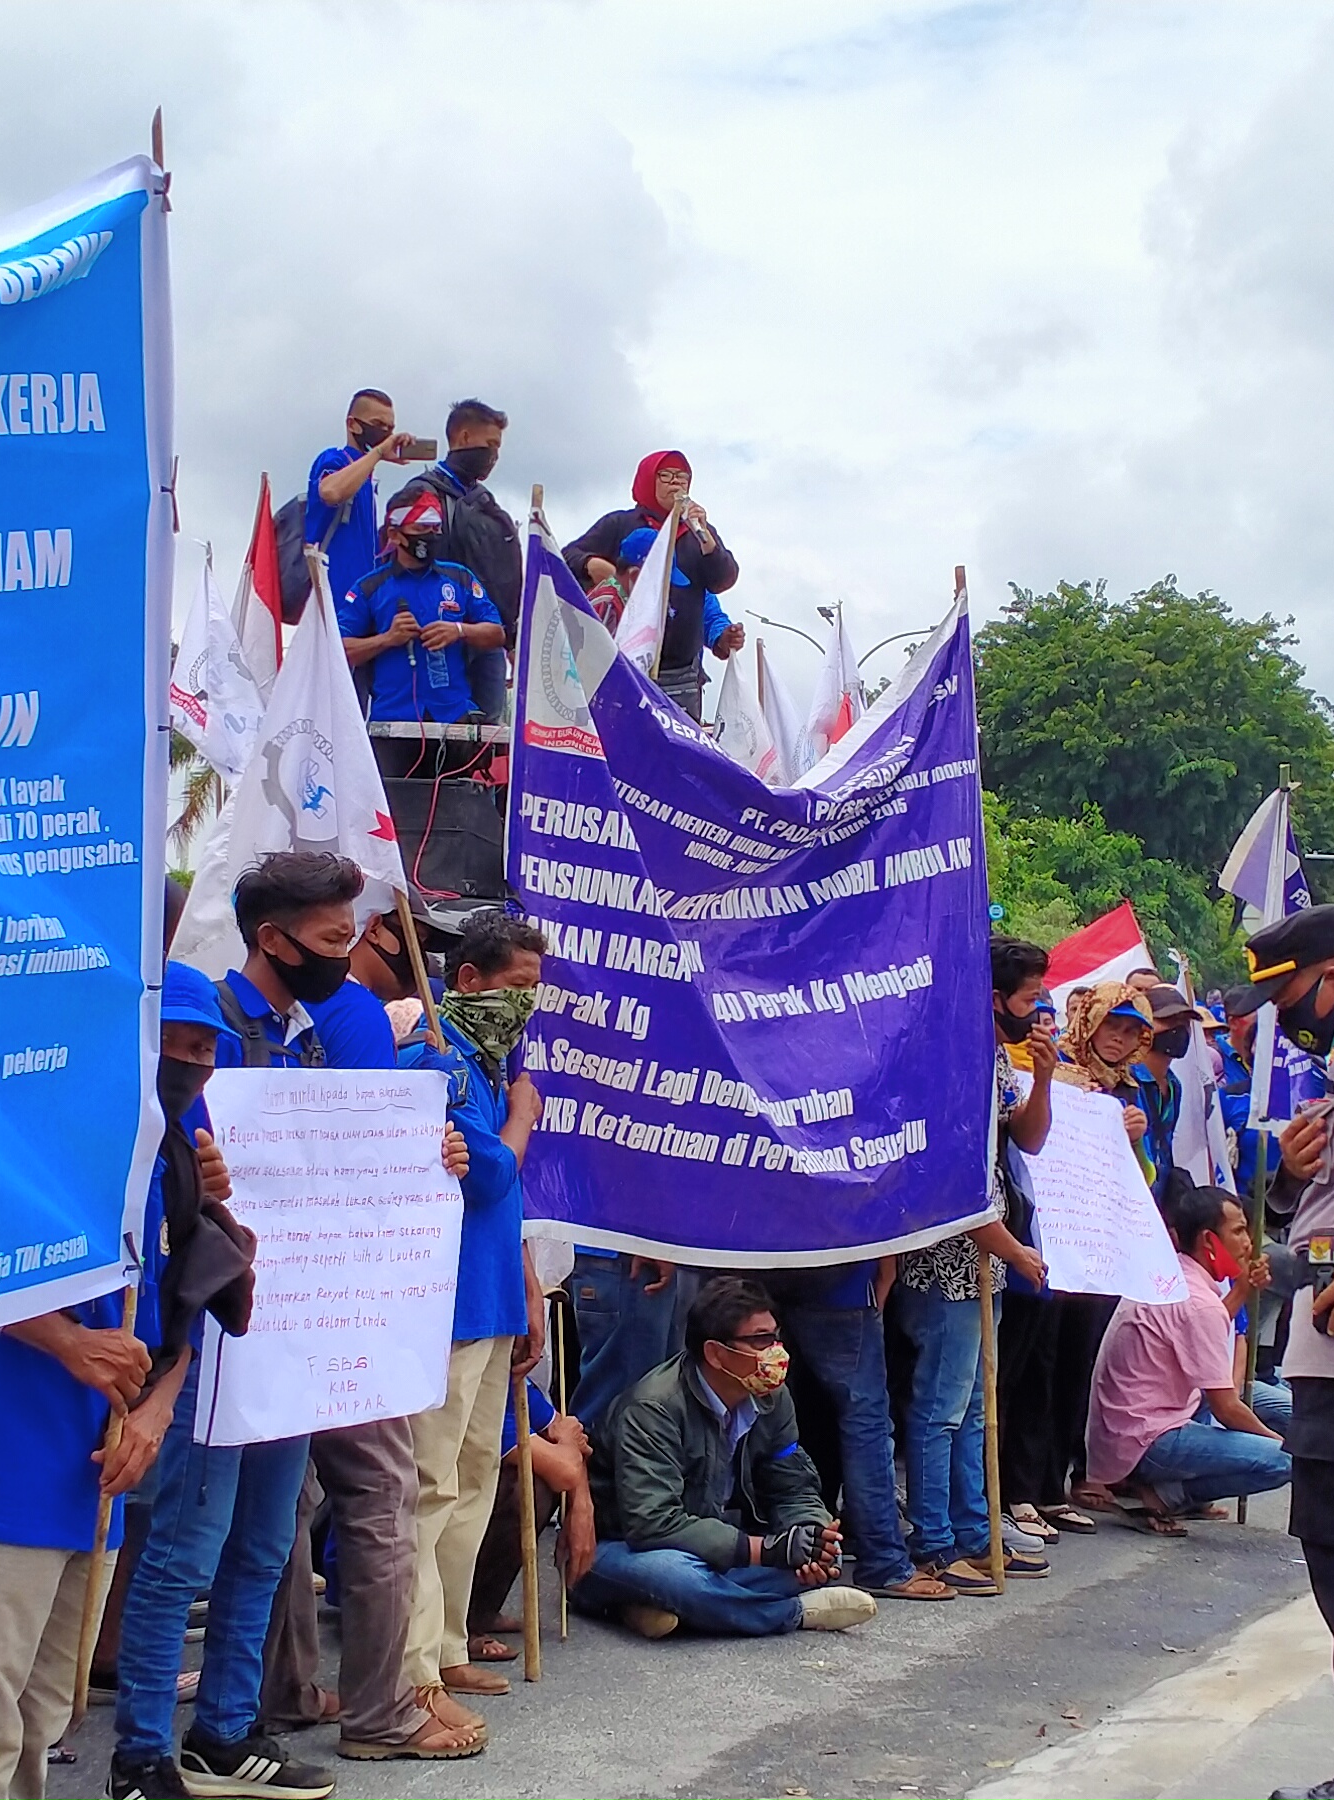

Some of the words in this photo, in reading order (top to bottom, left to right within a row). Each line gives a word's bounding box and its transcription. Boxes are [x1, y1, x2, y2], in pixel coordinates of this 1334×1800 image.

[9, 774, 66, 807] layak
[871, 797, 908, 822] 2015
[14, 809, 38, 840] 70
[41, 805, 103, 843] perak
[670, 810, 734, 847] MENTERI
[23, 838, 140, 878] pengusaha.
[807, 859, 880, 905] MOBIL
[4, 912, 67, 945] berikan
[613, 995, 652, 1041] Kg
[711, 990, 746, 1024] 40
[740, 983, 813, 1022] Perak
[810, 977, 847, 1014] Kg
[845, 953, 934, 1004] Menjadi
[2, 1042, 69, 1080] pekerja
[550, 1038, 644, 1093] Sesuai
[641, 1060, 701, 1106] Lagi
[540, 1095, 579, 1134] PKB
[578, 1101, 721, 1163] Ketentuan
[720, 1131, 751, 1167] di
[13, 1242, 45, 1277] TDK
[44, 1230, 90, 1268] sesuai
[315, 1393, 387, 1419] KAMPAR
